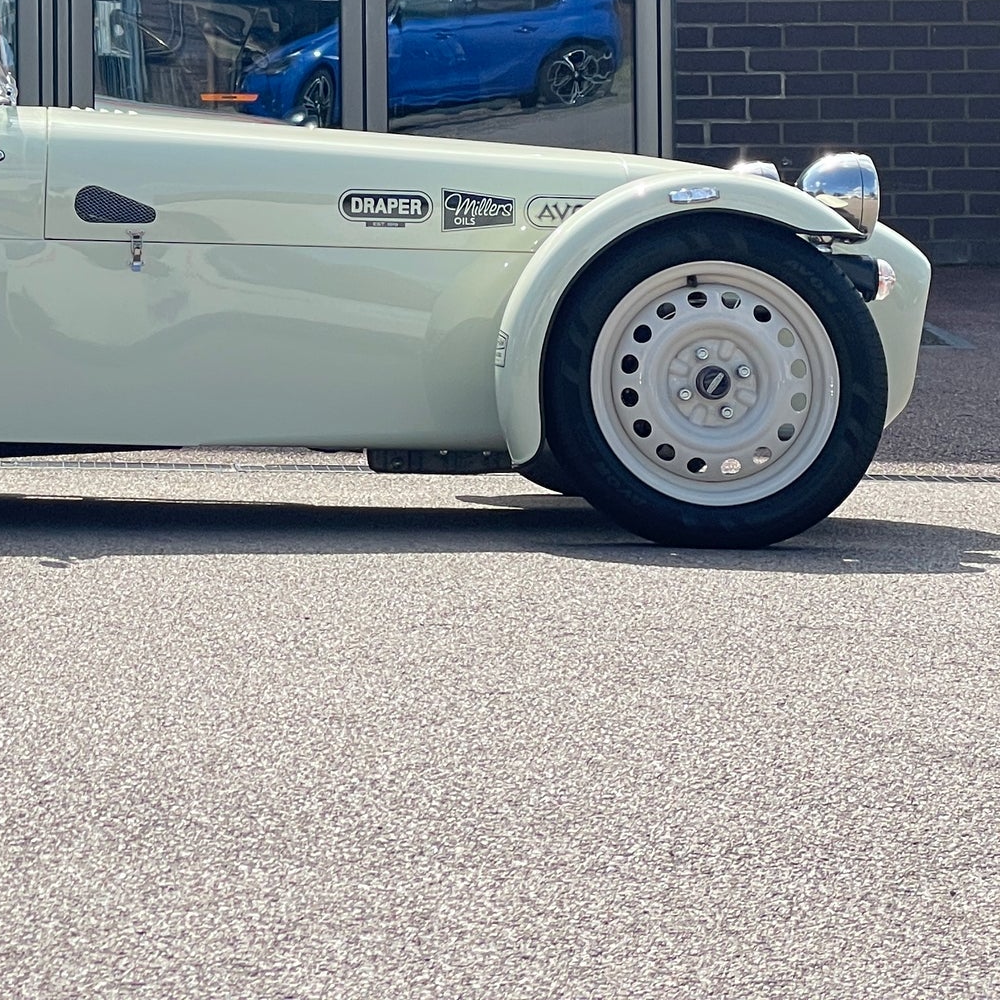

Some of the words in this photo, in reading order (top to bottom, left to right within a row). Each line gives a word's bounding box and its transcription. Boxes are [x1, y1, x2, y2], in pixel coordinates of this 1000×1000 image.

[351, 197, 422, 215] DRAPER
[445, 193, 513, 217] Millers
[454, 217, 476, 226] OILS
